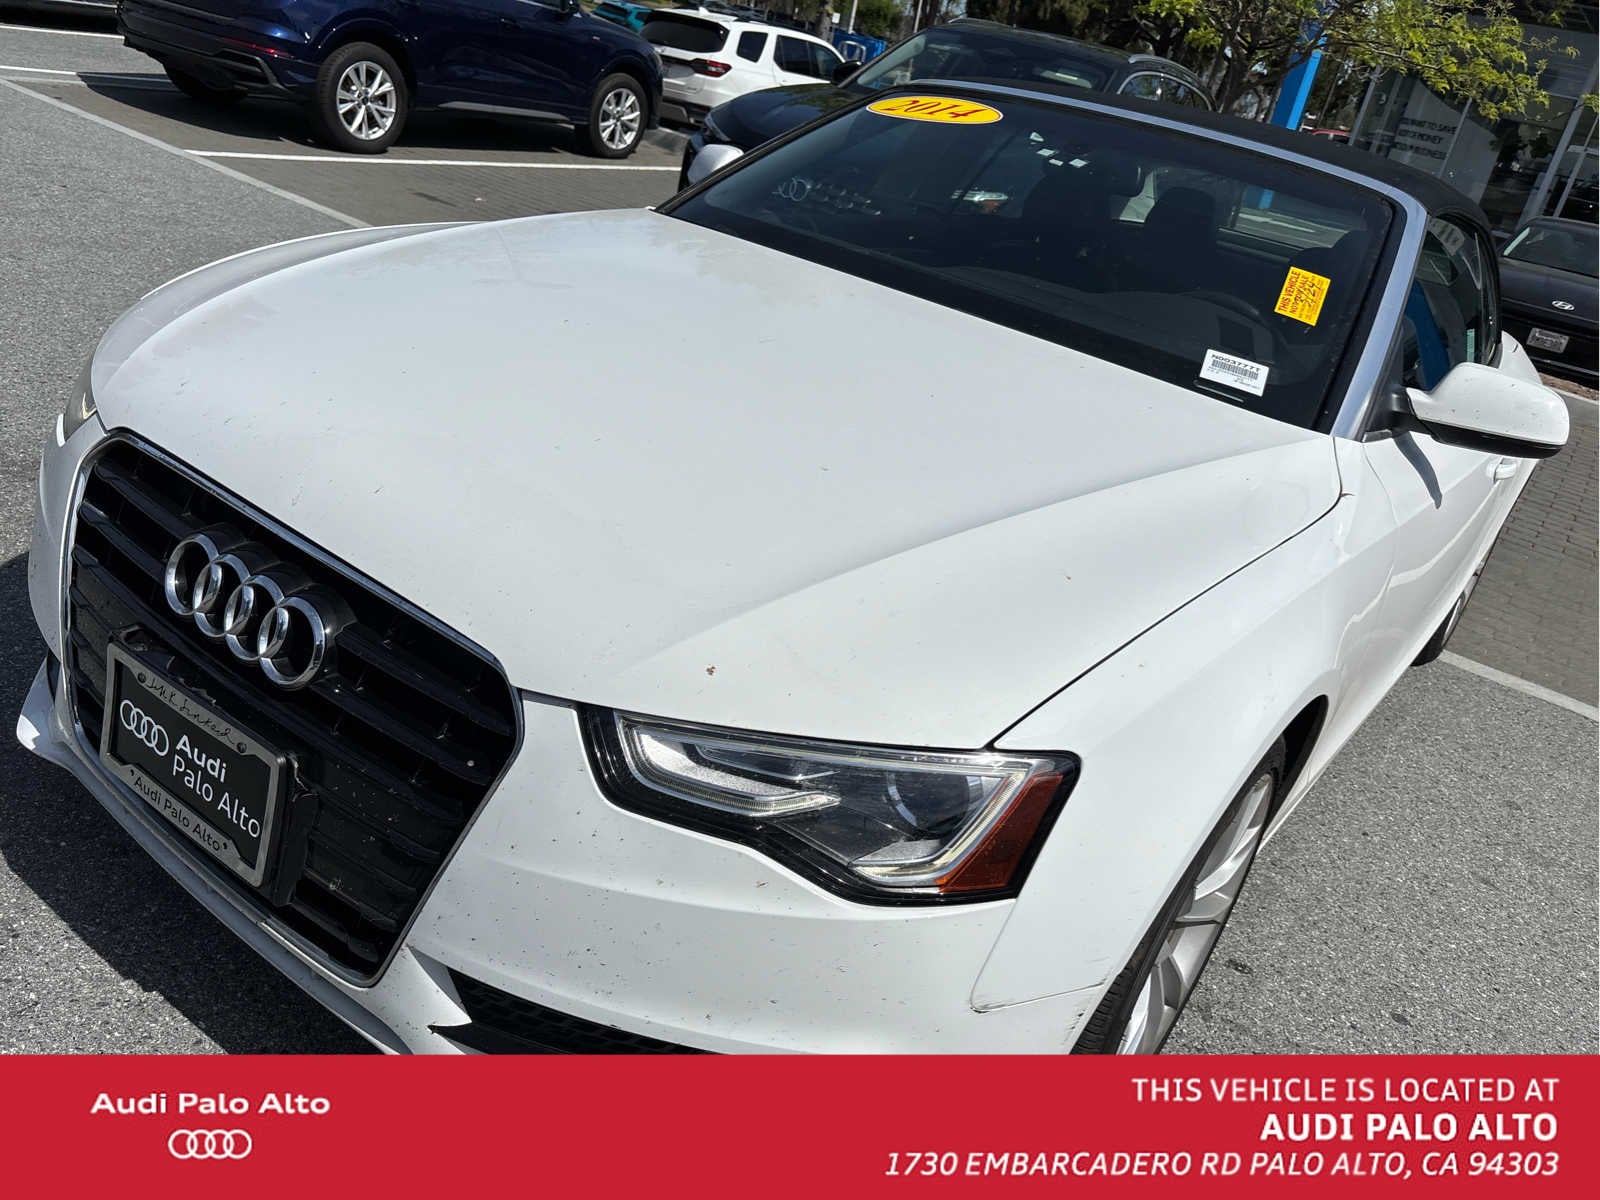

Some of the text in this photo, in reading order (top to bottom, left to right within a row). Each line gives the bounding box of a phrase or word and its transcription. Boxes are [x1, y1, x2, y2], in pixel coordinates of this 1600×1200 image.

[880, 100, 990, 118] 2014
[1278, 270, 1301, 312] THIS VEHICLE
[175, 734, 228, 783] Audi
[134, 776, 220, 851] Audi Palo Alto
[172, 754, 261, 838] Palo Alto
